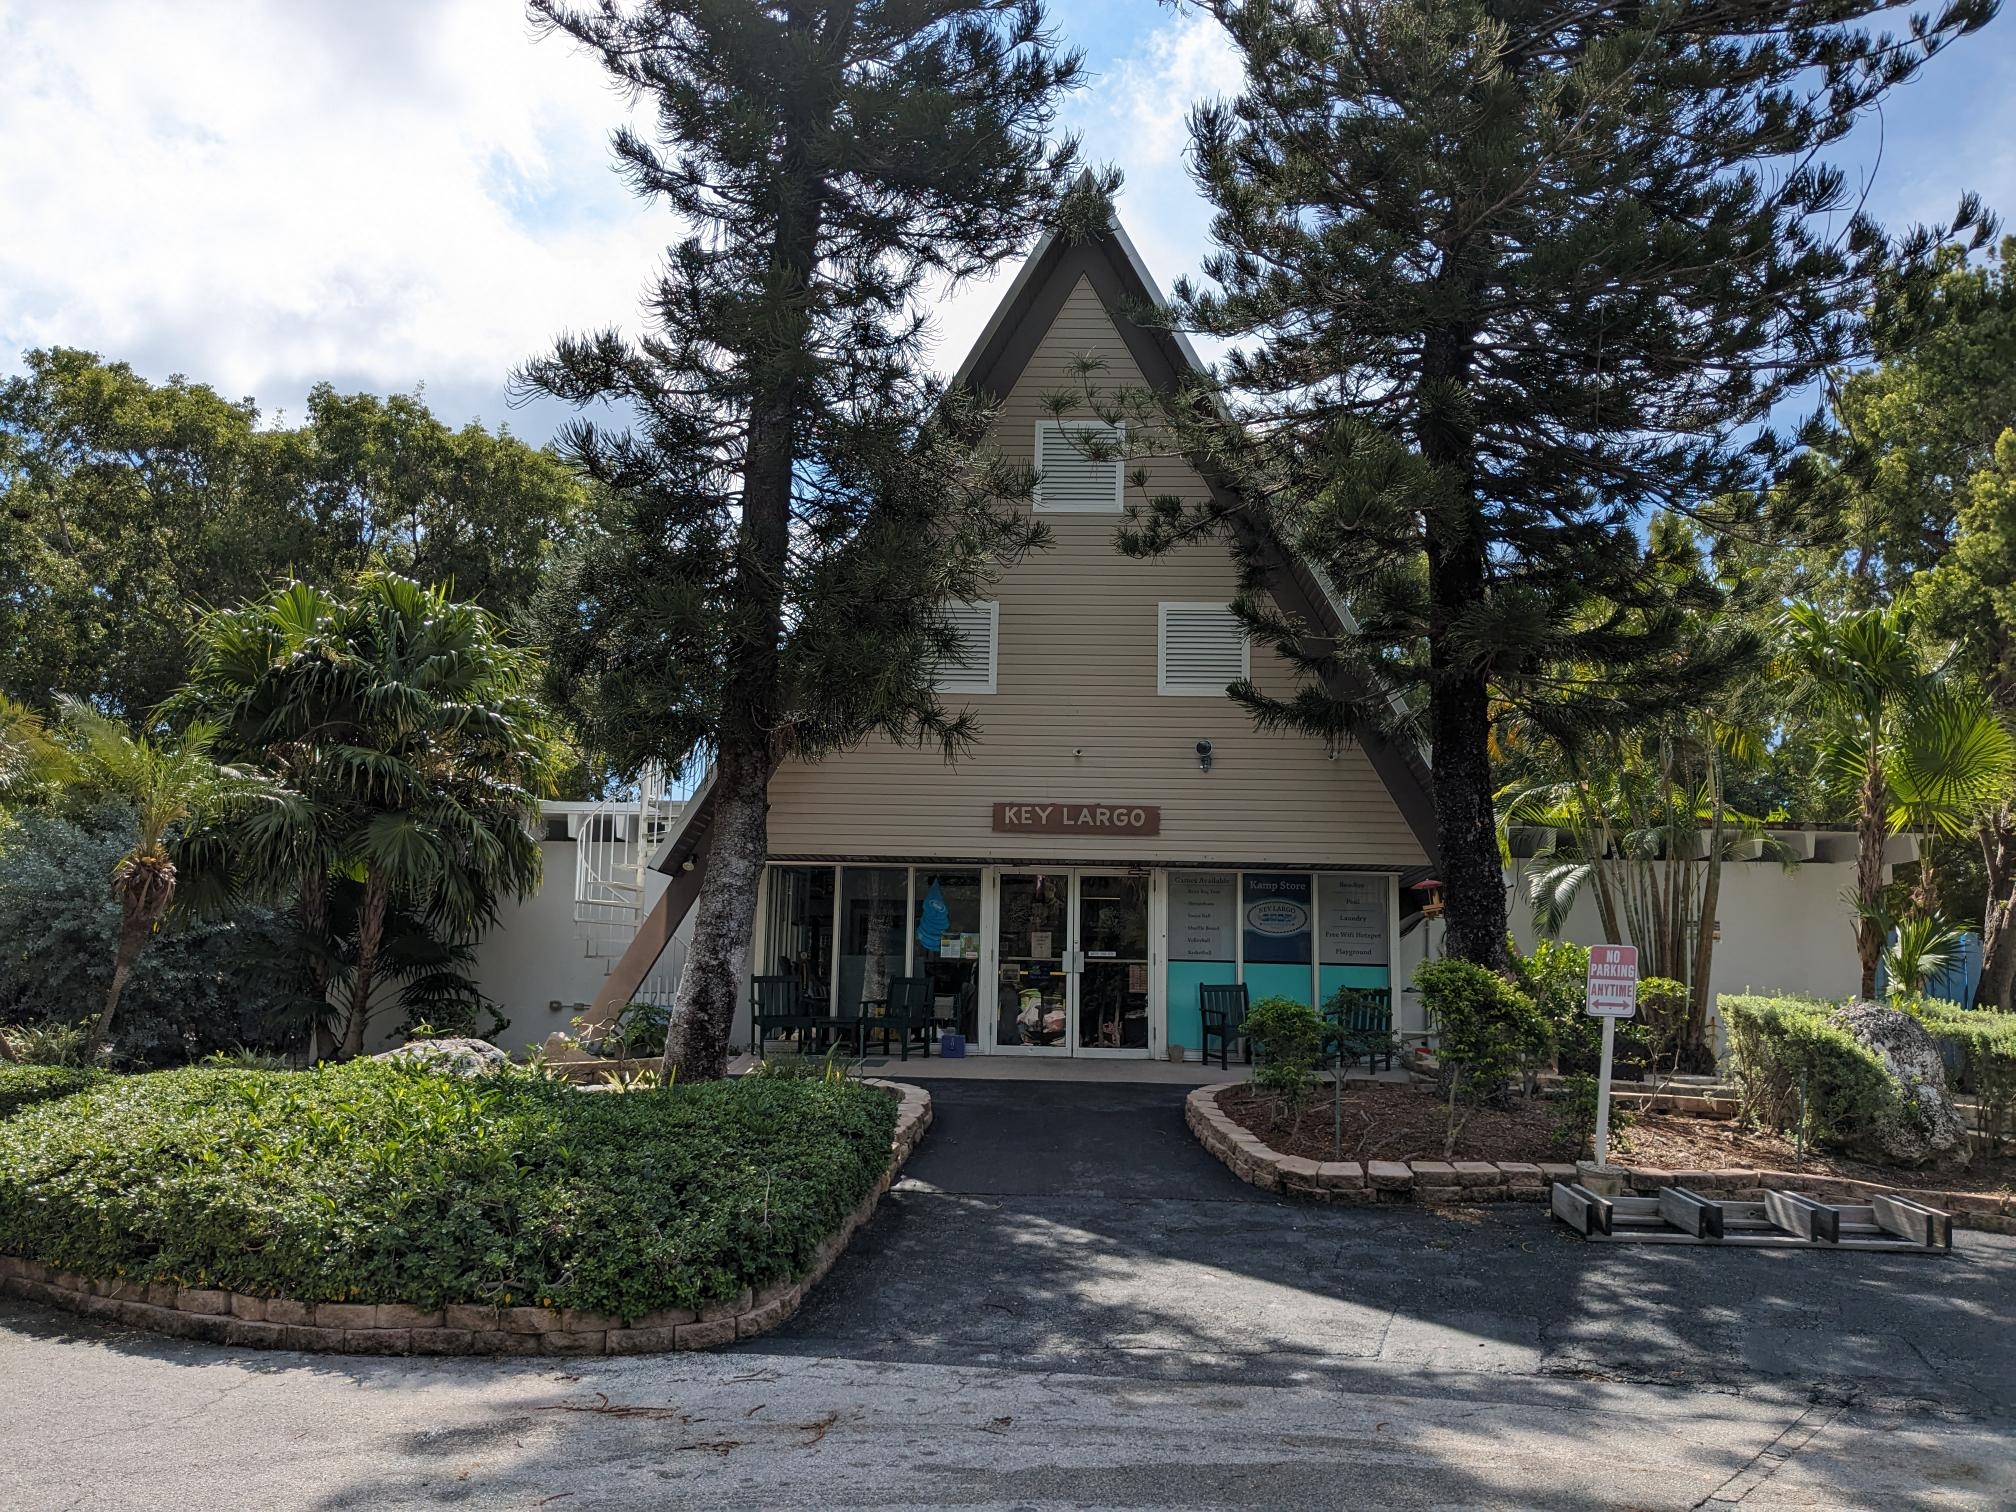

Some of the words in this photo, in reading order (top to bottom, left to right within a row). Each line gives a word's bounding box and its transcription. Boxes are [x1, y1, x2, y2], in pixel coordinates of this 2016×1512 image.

[1005, 806, 1054, 825] KEY
[1063, 807, 1145, 827] LARGO
[1200, 876, 1230, 884] Available
[1249, 880, 1277, 892] Kamp
[1279, 880, 1306, 890] Store
[1258, 905, 1273, 913] KEY
[1273, 905, 1296, 914] LARGO
[1340, 914, 1367, 923] Laundry
[1335, 948, 1372, 957] Playground
[1606, 950, 1621, 963] NO
[1590, 963, 1635, 978] PARKING
[1590, 983, 1633, 997] ANYTIME
